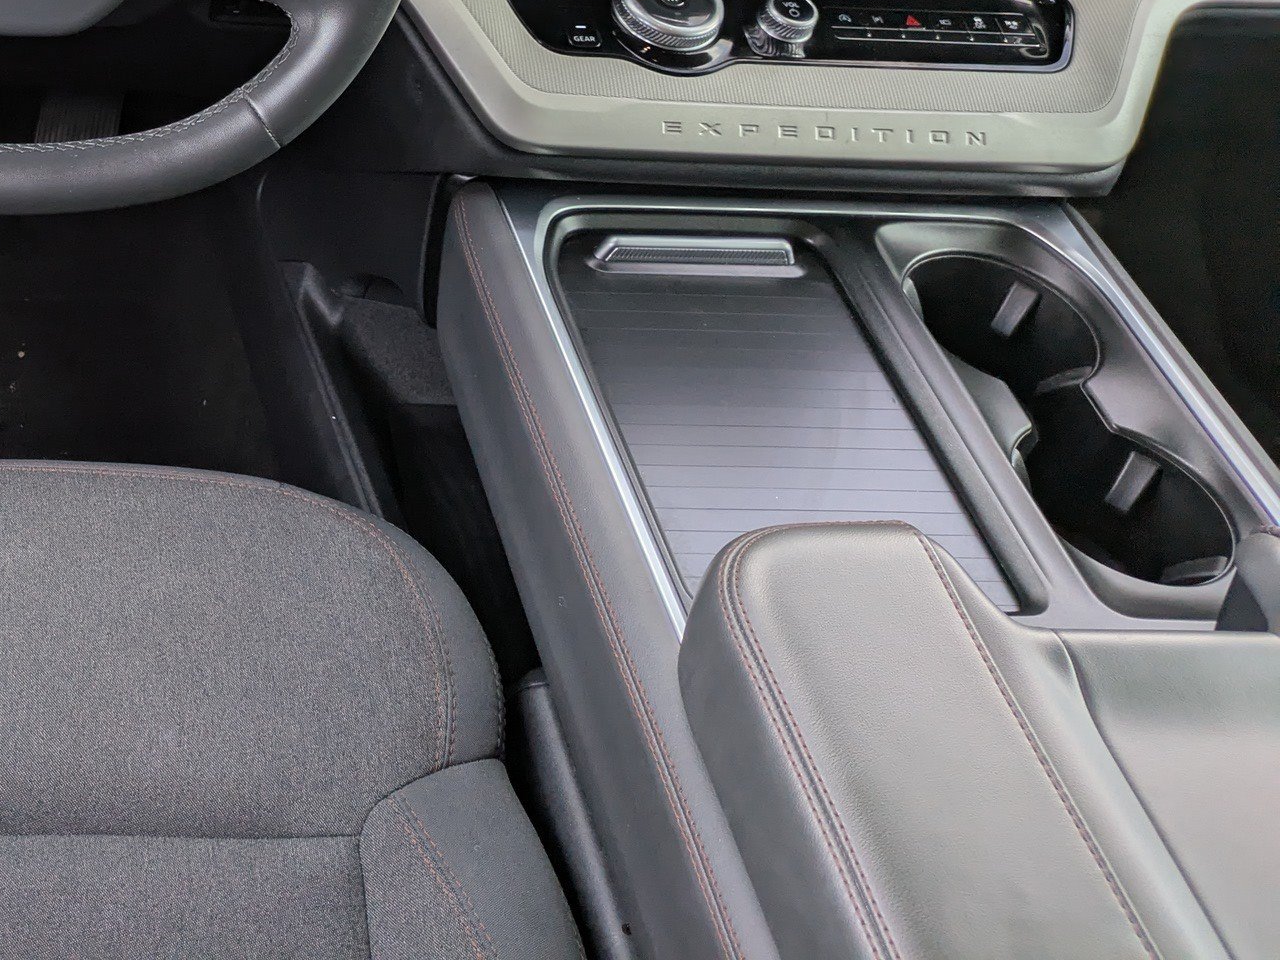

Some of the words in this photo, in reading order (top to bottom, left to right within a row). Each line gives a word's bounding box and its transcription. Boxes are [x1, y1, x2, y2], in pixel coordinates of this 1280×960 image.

[782, 1, 800, 10] VOL
[573, 34, 596, 43] GEAR
[661, 120, 987, 146] EXPEDITION
